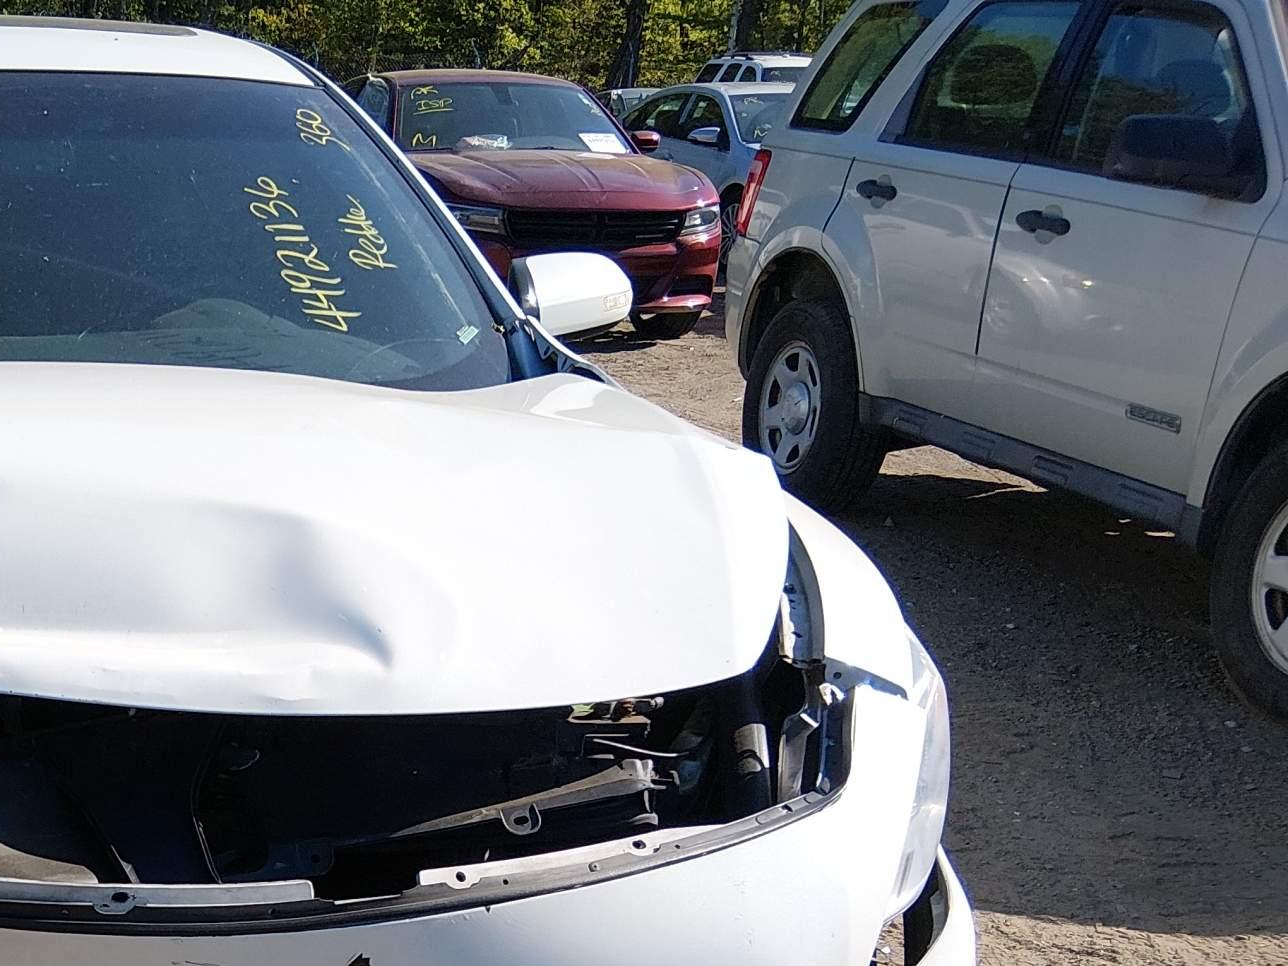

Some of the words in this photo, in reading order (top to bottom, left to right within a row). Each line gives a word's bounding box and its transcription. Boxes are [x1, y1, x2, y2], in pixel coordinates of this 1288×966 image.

[296, 108, 351, 151] 360
[412, 132, 437, 148] M
[244, 176, 363, 332] 44921136
